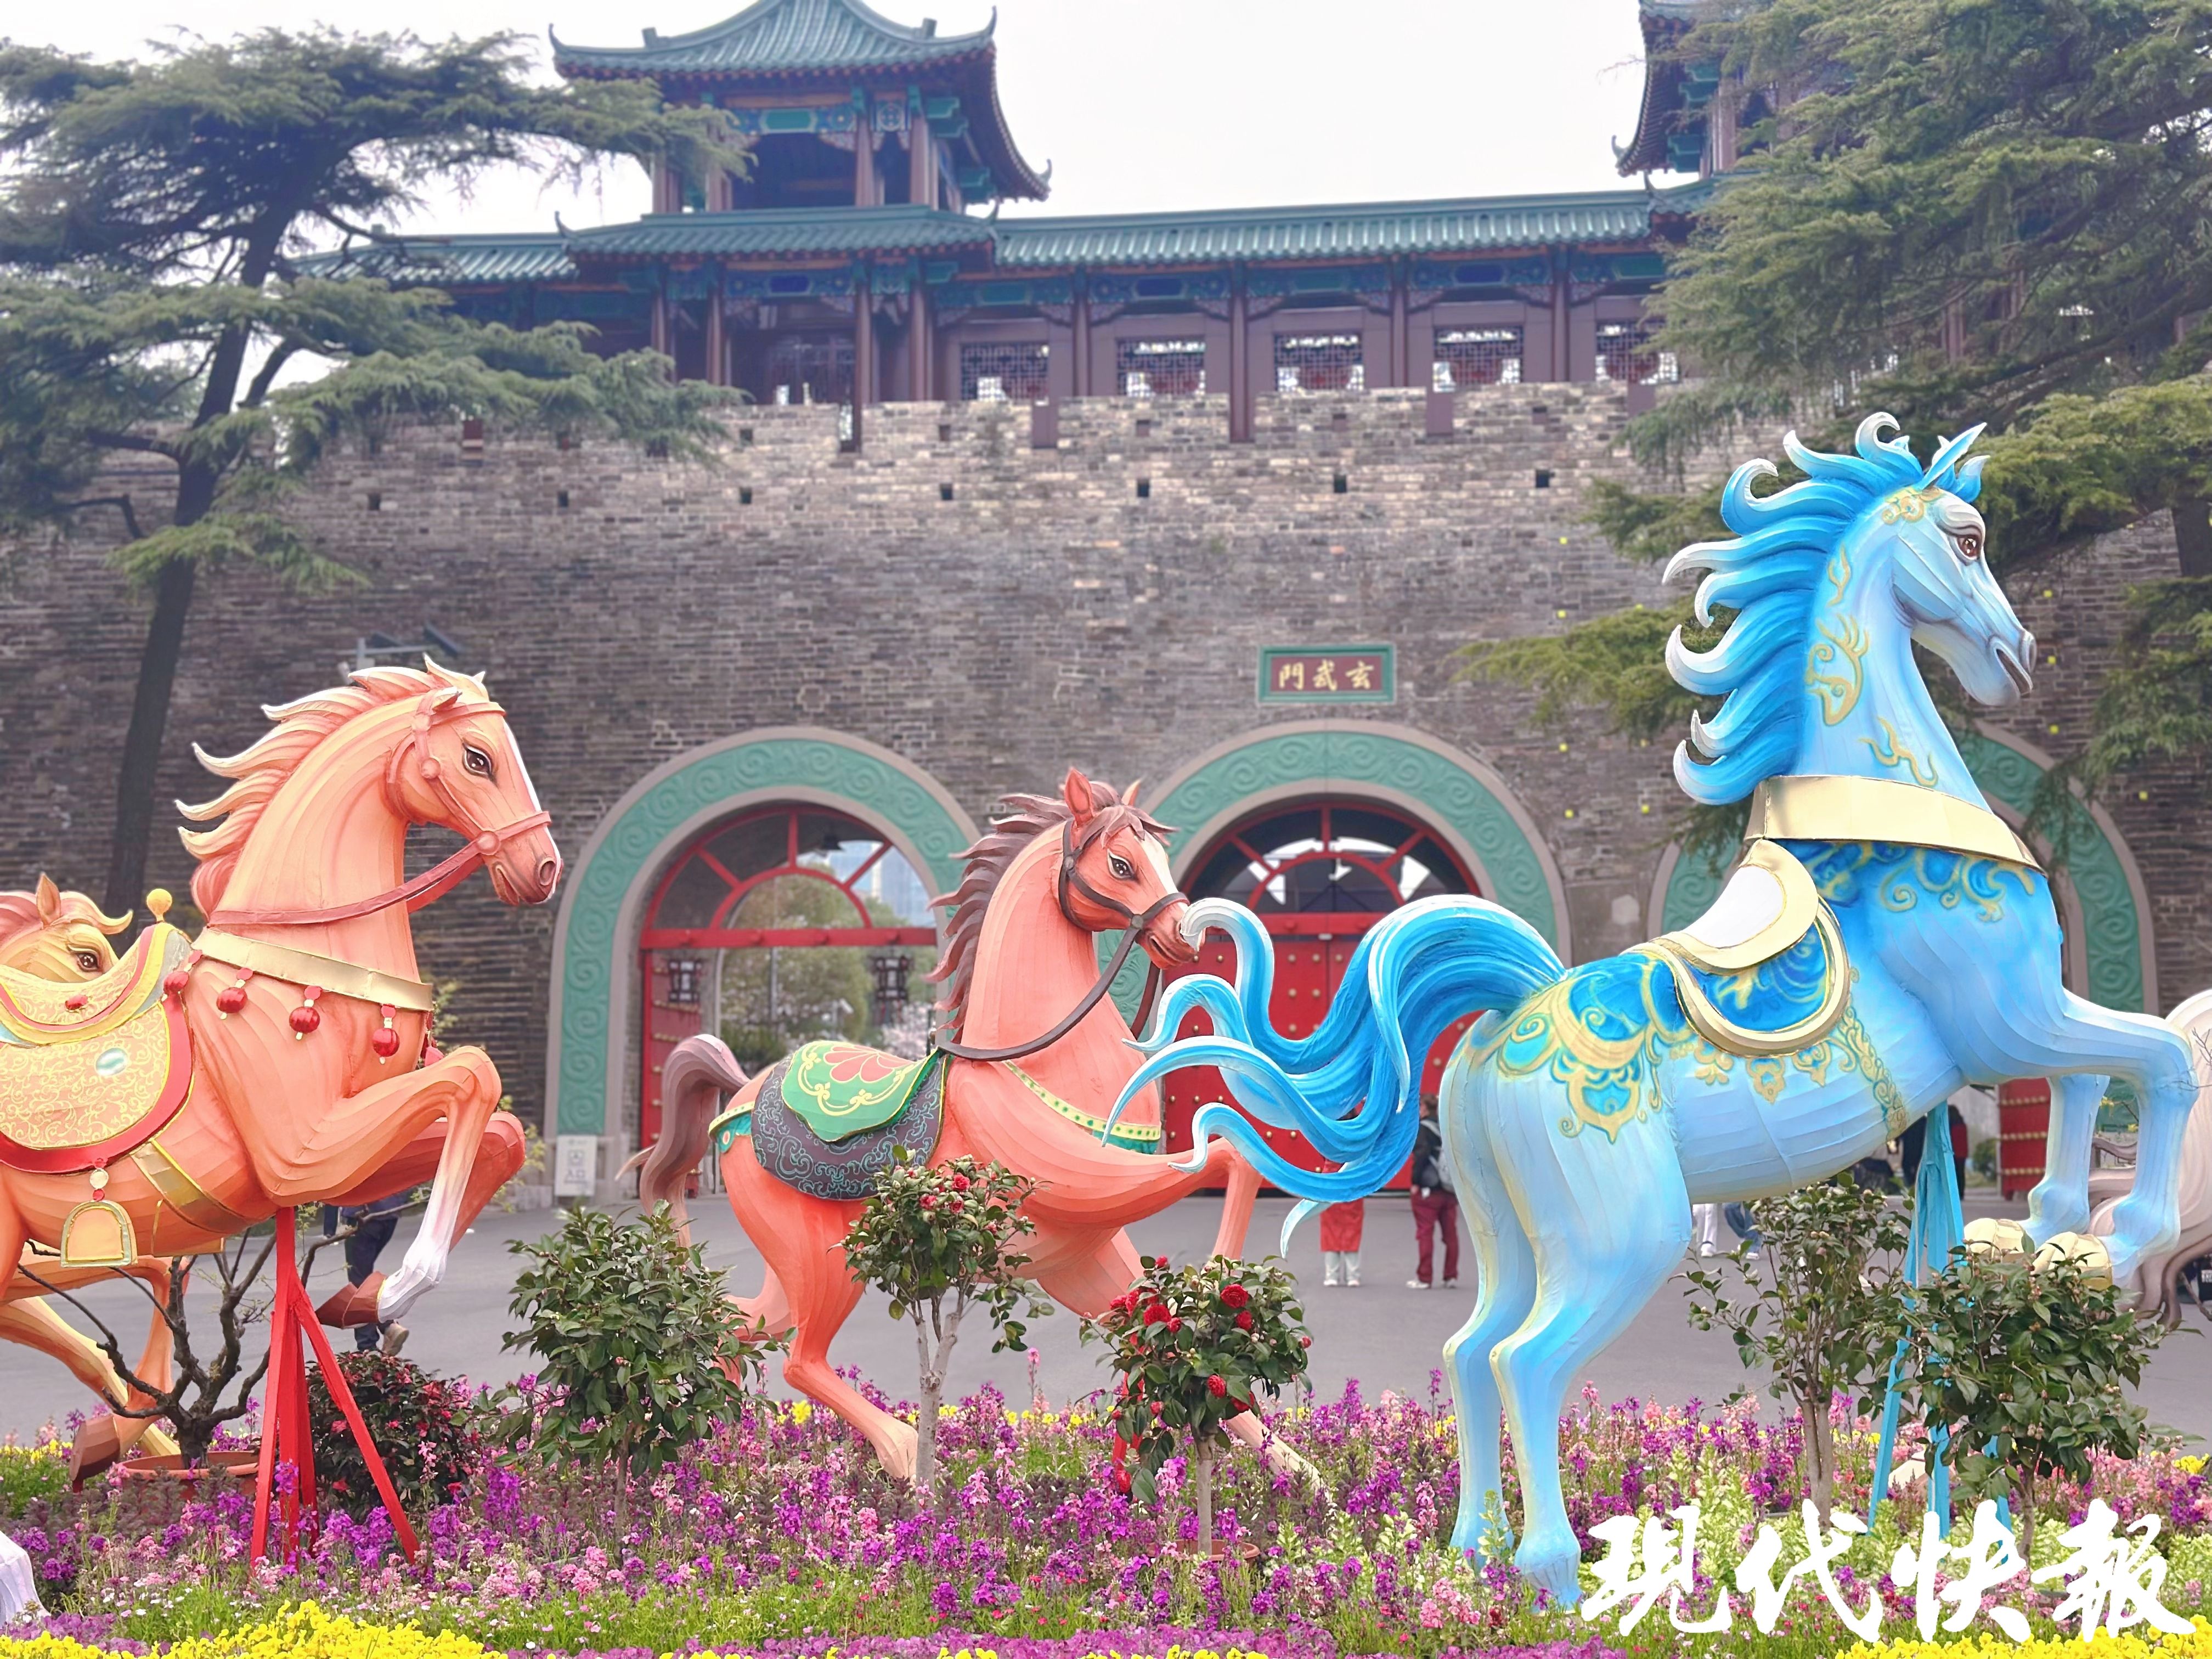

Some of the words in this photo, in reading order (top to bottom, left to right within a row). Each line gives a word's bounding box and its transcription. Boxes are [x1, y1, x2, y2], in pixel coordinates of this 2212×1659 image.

[1278, 659, 1374, 691] 玄武門
[565, 1169, 586, 1179] 入口
